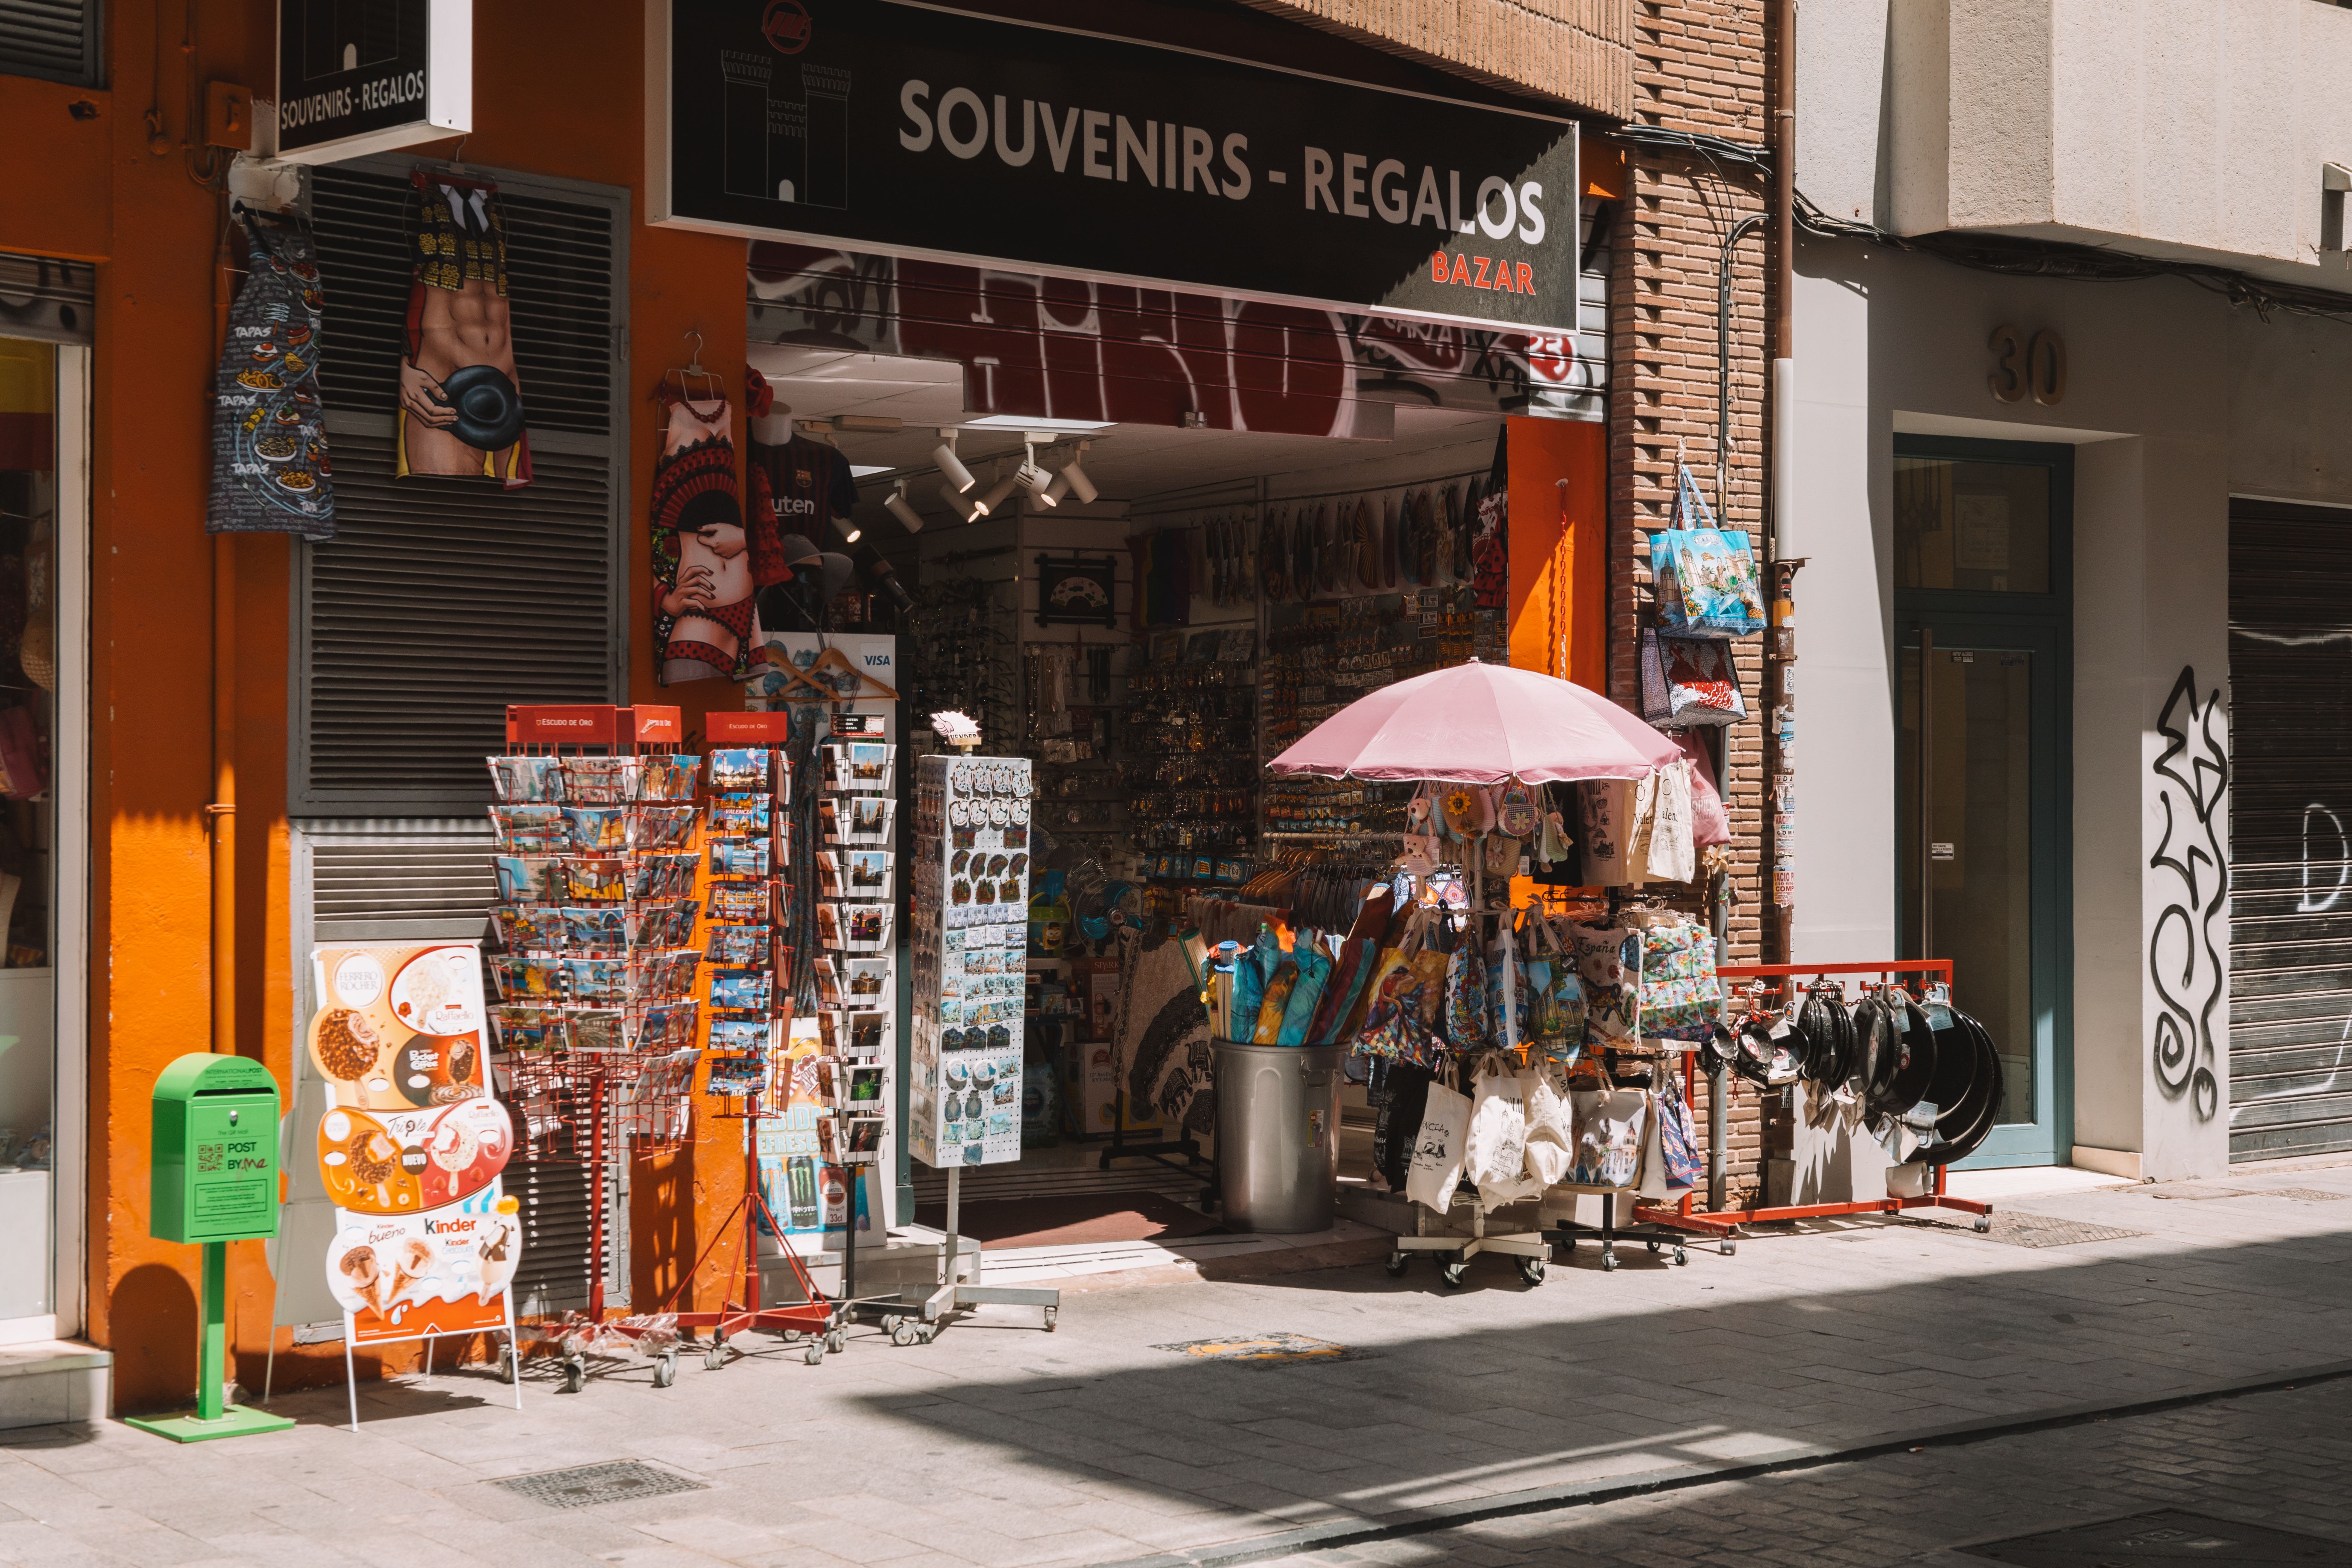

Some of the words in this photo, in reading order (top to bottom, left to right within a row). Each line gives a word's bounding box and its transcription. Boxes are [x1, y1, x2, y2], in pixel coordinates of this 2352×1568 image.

[281, 87, 351, 130] SOUVENIRS
[363, 70, 425, 112] REGALOS
[899, 79, 1251, 200] SOUVENIRS
[1305, 146, 1545, 245] REGALOS
[1432, 250, 1536, 296] BAZAR
[234, 326, 273, 337] TAPAS
[1988, 325, 2067, 406] 30
[217, 395, 257, 406] TAPAS
[230, 463, 270, 475] TAPAS
[772, 496, 815, 514] uten
[863, 655, 890, 665] VISA
[1692, 797, 1717, 812] OPICAL
[1774, 872, 1789, 882] VACIO
[1577, 937, 1615, 957] España
[1095, 962, 1119, 972] SPARK
[340, 971, 378, 980] FERRERO
[340, 980, 378, 991] ROCHER
[435, 1011, 474, 1021] Raffaello
[409, 1050, 439, 1062] Pocket
[410, 1059, 439, 1070] Coffee
[1510, 1096, 1525, 1115] VAL
[469, 1110, 499, 1119] Raffaello
[1423, 1120, 1444, 1133] ENCIA
[228, 1142, 257, 1153] POST
[757, 1135, 820, 1154] EFRESC
[402, 1153, 427, 1166] NUEVO
[830, 1214, 843, 1222] 33cl
[424, 1218, 476, 1235] Kinder
[369, 1228, 405, 1244] bueno
[441, 1246, 475, 1255] CHOCOLATE
